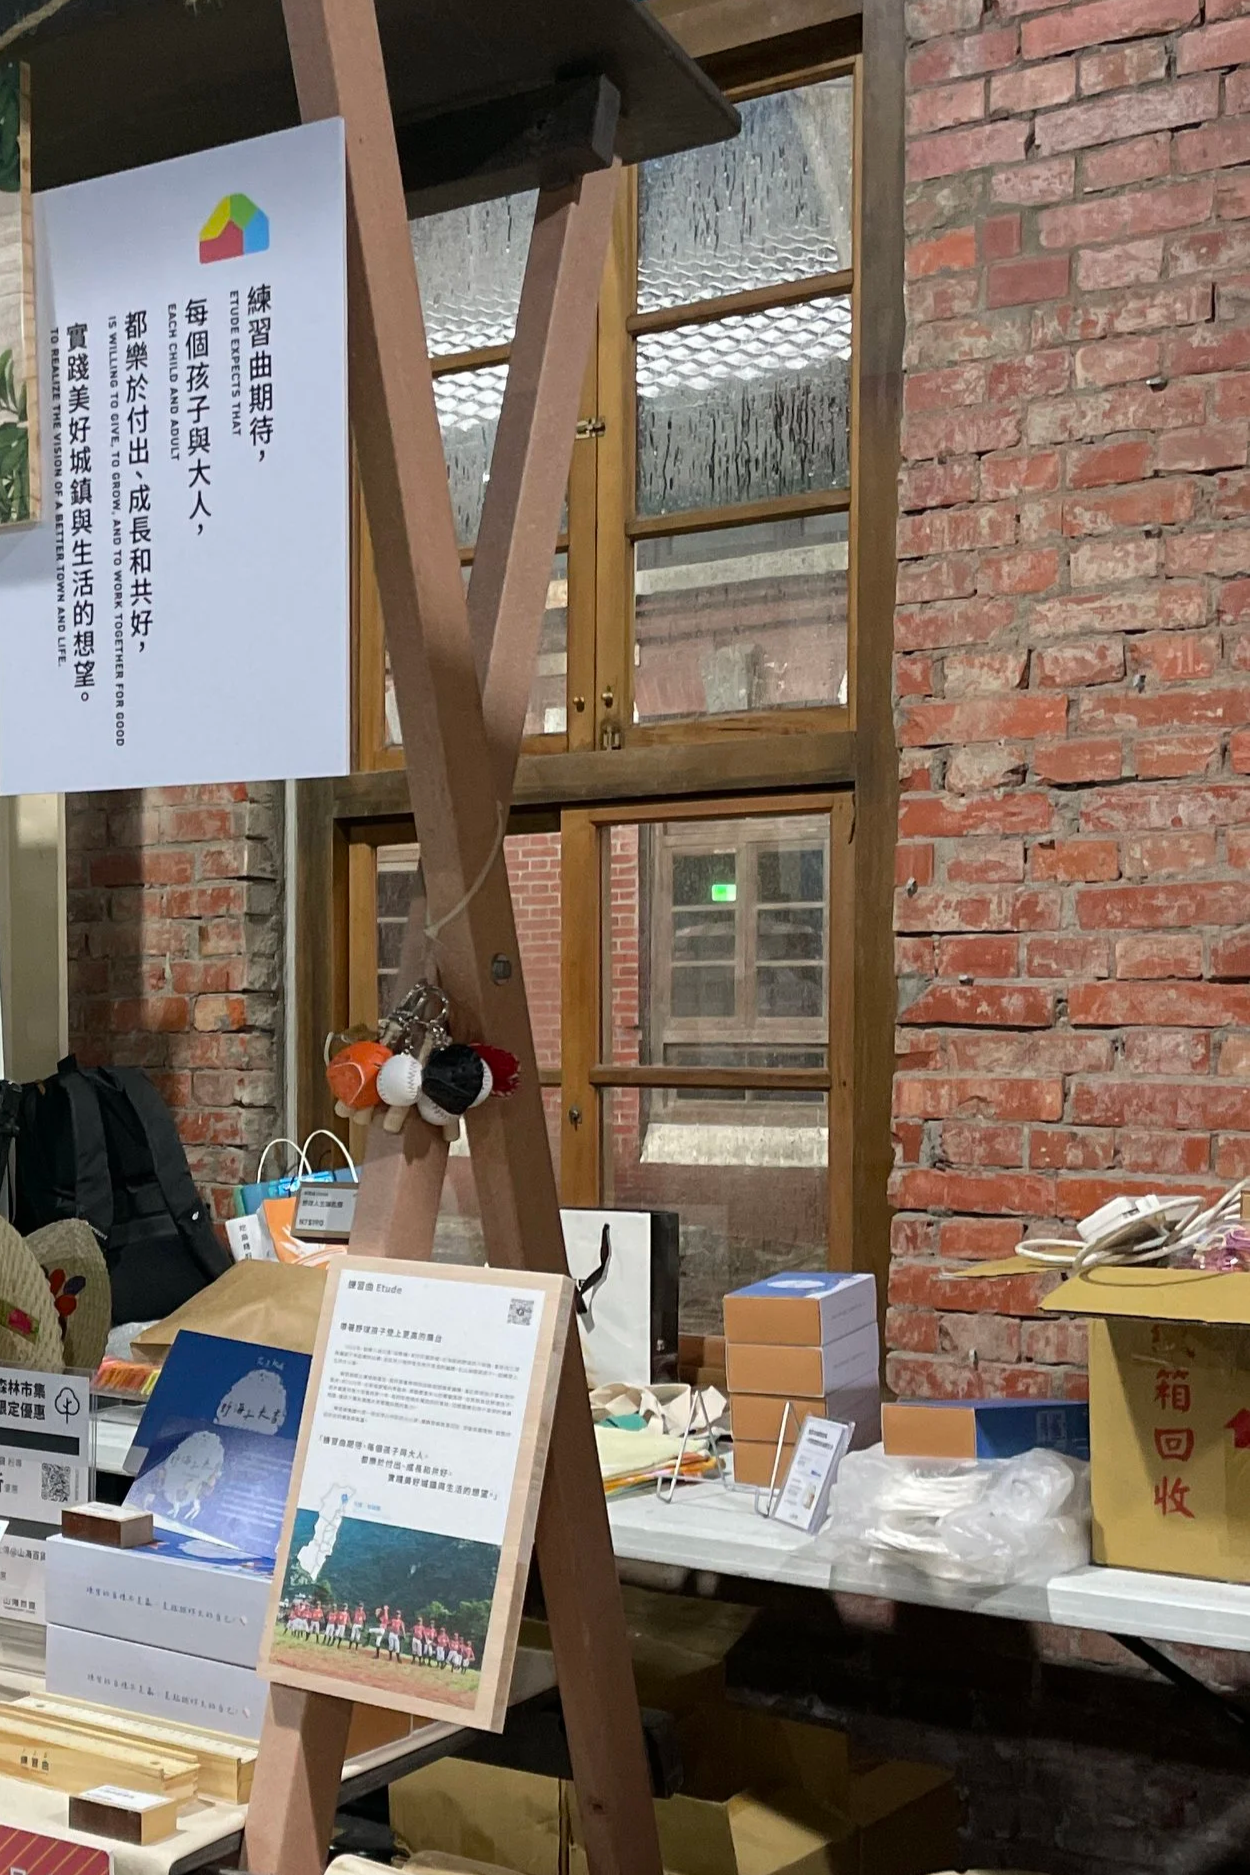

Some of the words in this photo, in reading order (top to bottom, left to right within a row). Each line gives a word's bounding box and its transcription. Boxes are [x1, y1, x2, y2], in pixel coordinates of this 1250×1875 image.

[108, 315, 116, 329] IS
[168, 303, 177, 338] EACH
[229, 290, 240, 334] ETUDE
[50, 327, 59, 344] TO
[51, 348, 60, 400] REALIZE
[108, 332, 118, 388] WILLING
[168, 342, 178, 383] CHILD
[230, 339, 241, 398] EXPECTS
[52, 404, 62, 429] THE
[110, 392, 119, 409] TO
[169, 387, 179, 414] AND
[110, 413, 120, 447] GIVE,
[231, 404, 242, 436] THAT
[53, 432, 63, 477] VISION
[170, 419, 180, 461] ADULT
[111, 451, 120, 467] TO
[54, 481, 63, 497] OF
[111, 472, 121, 515] GROW,
[55, 514, 65, 561] BETTER
[112, 519, 122, 546] AND
[113, 550, 122, 566] TO
[56, 564, 65, 602] TOWN
[113, 570, 123, 609] WORK
[57, 607, 66, 632] AND
[114, 613, 124, 679] TOGETHER
[115, 683, 124, 708] FOR
[115, 712, 125, 746] GOOD
[376, 1284, 403, 1295] Etude
